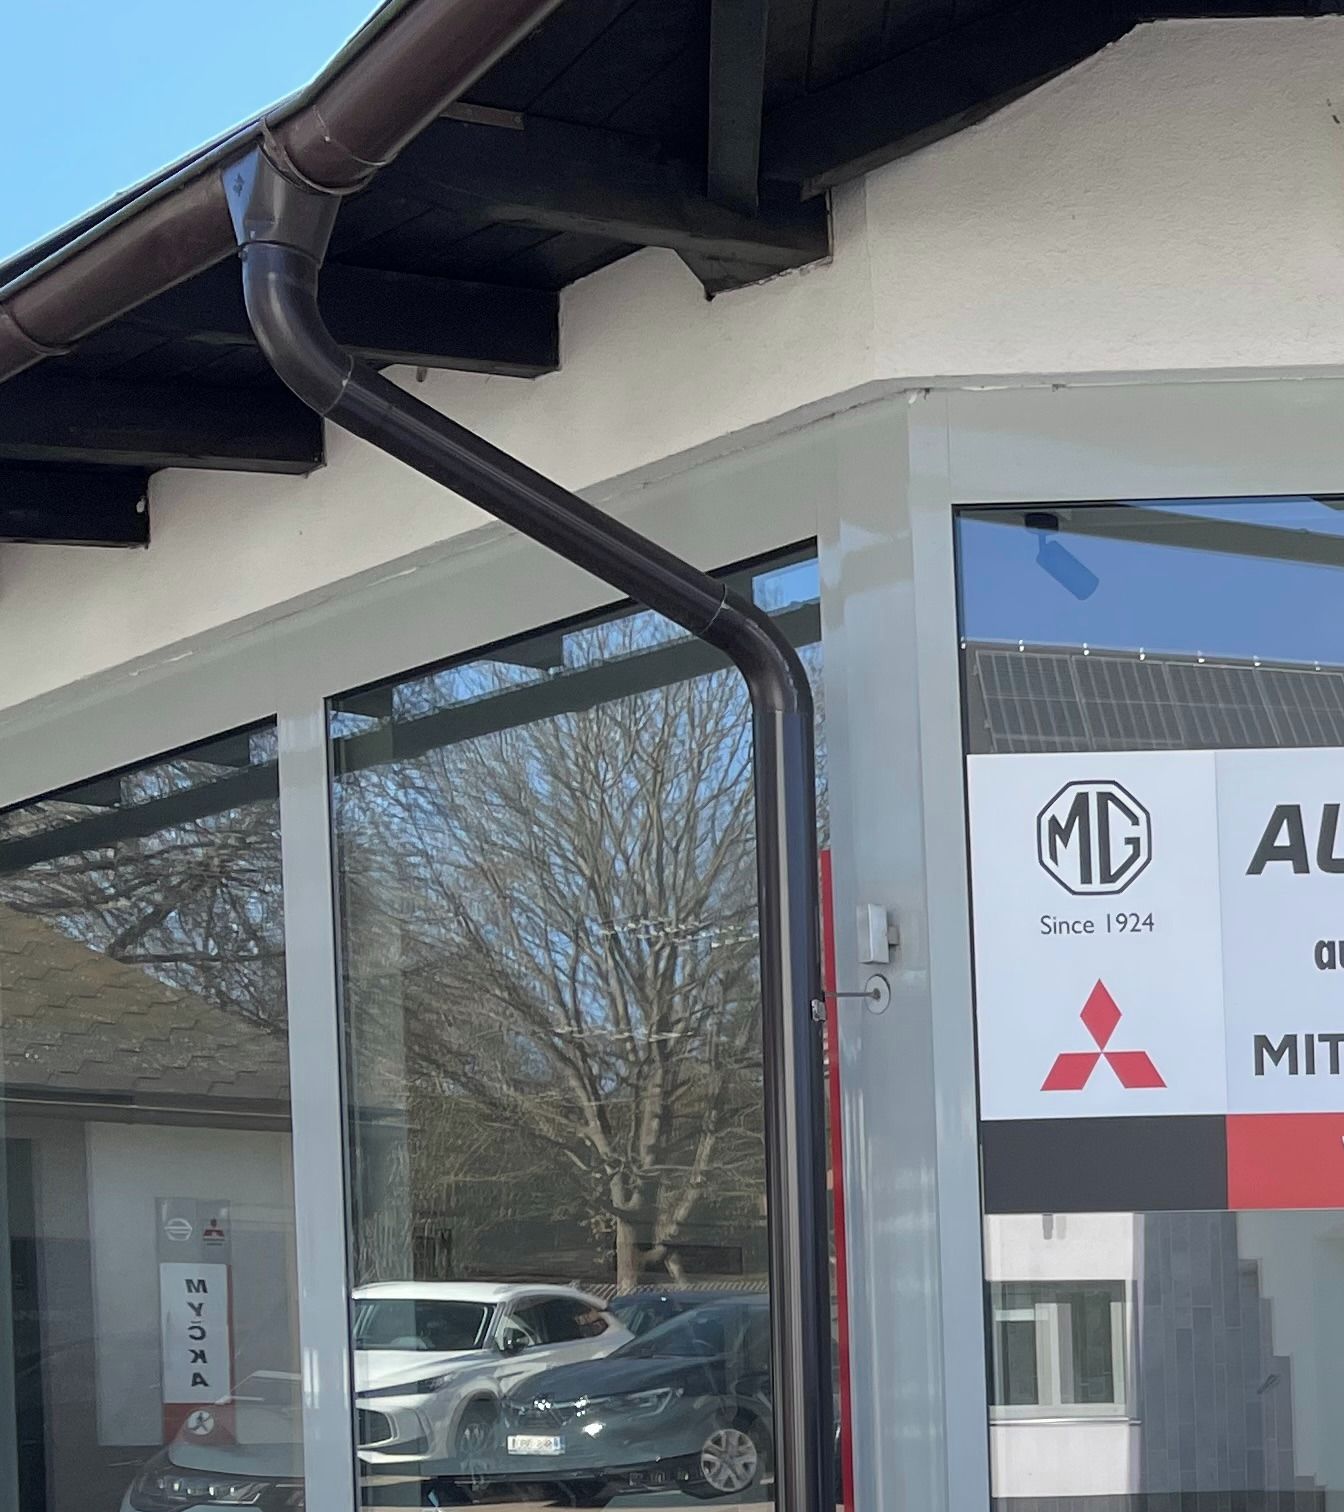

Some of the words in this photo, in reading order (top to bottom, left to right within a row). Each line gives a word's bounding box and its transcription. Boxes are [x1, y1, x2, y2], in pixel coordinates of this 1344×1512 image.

[1046, 789, 1143, 886] MG
[1040, 914, 1095, 935] Since
[1105, 912, 1155, 934] 1924
